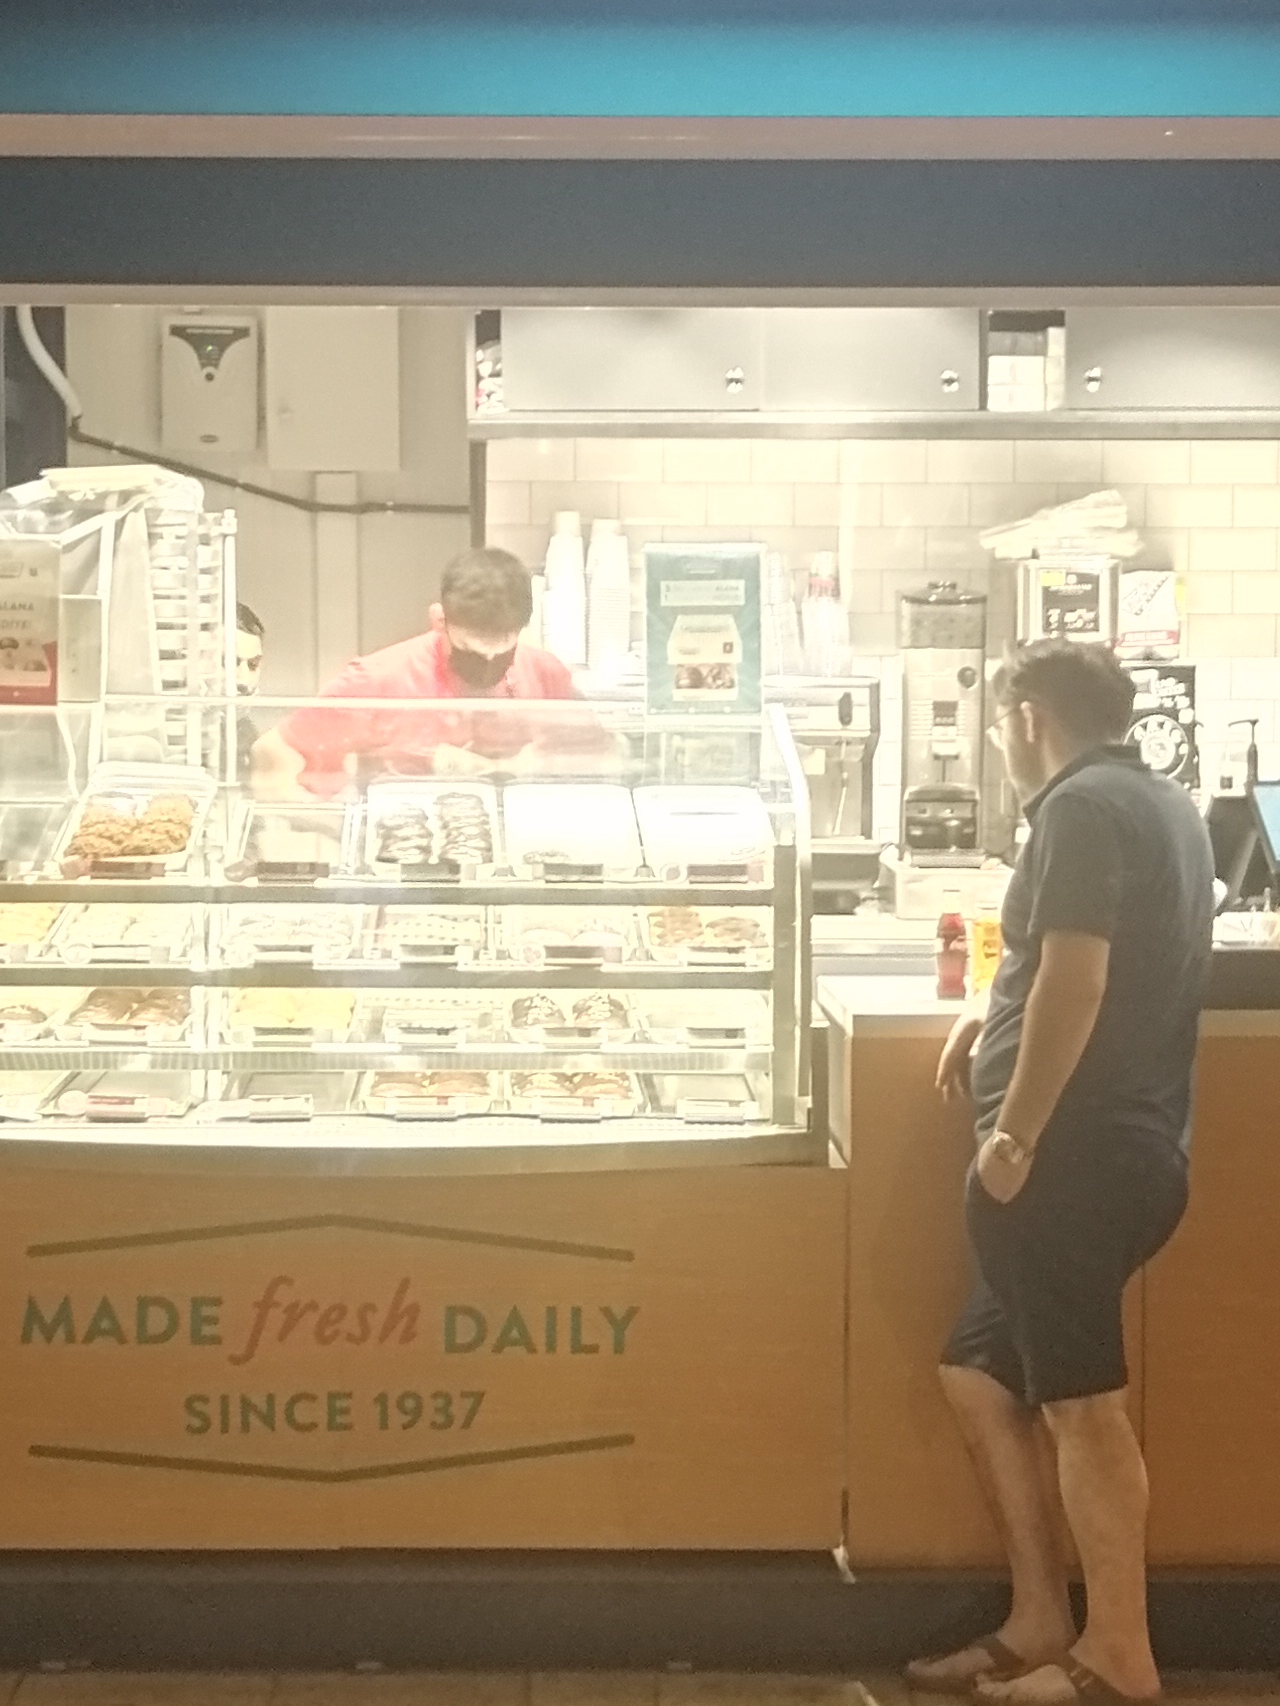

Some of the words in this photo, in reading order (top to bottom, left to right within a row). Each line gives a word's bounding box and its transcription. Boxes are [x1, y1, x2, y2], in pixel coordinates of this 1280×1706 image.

[20, 1295, 224, 1345] MADE
[228, 1275, 421, 1366] fresh
[442, 1304, 641, 1355] DAILY
[184, 1392, 354, 1435] SINCE
[375, 1390, 487, 1432] 1937
